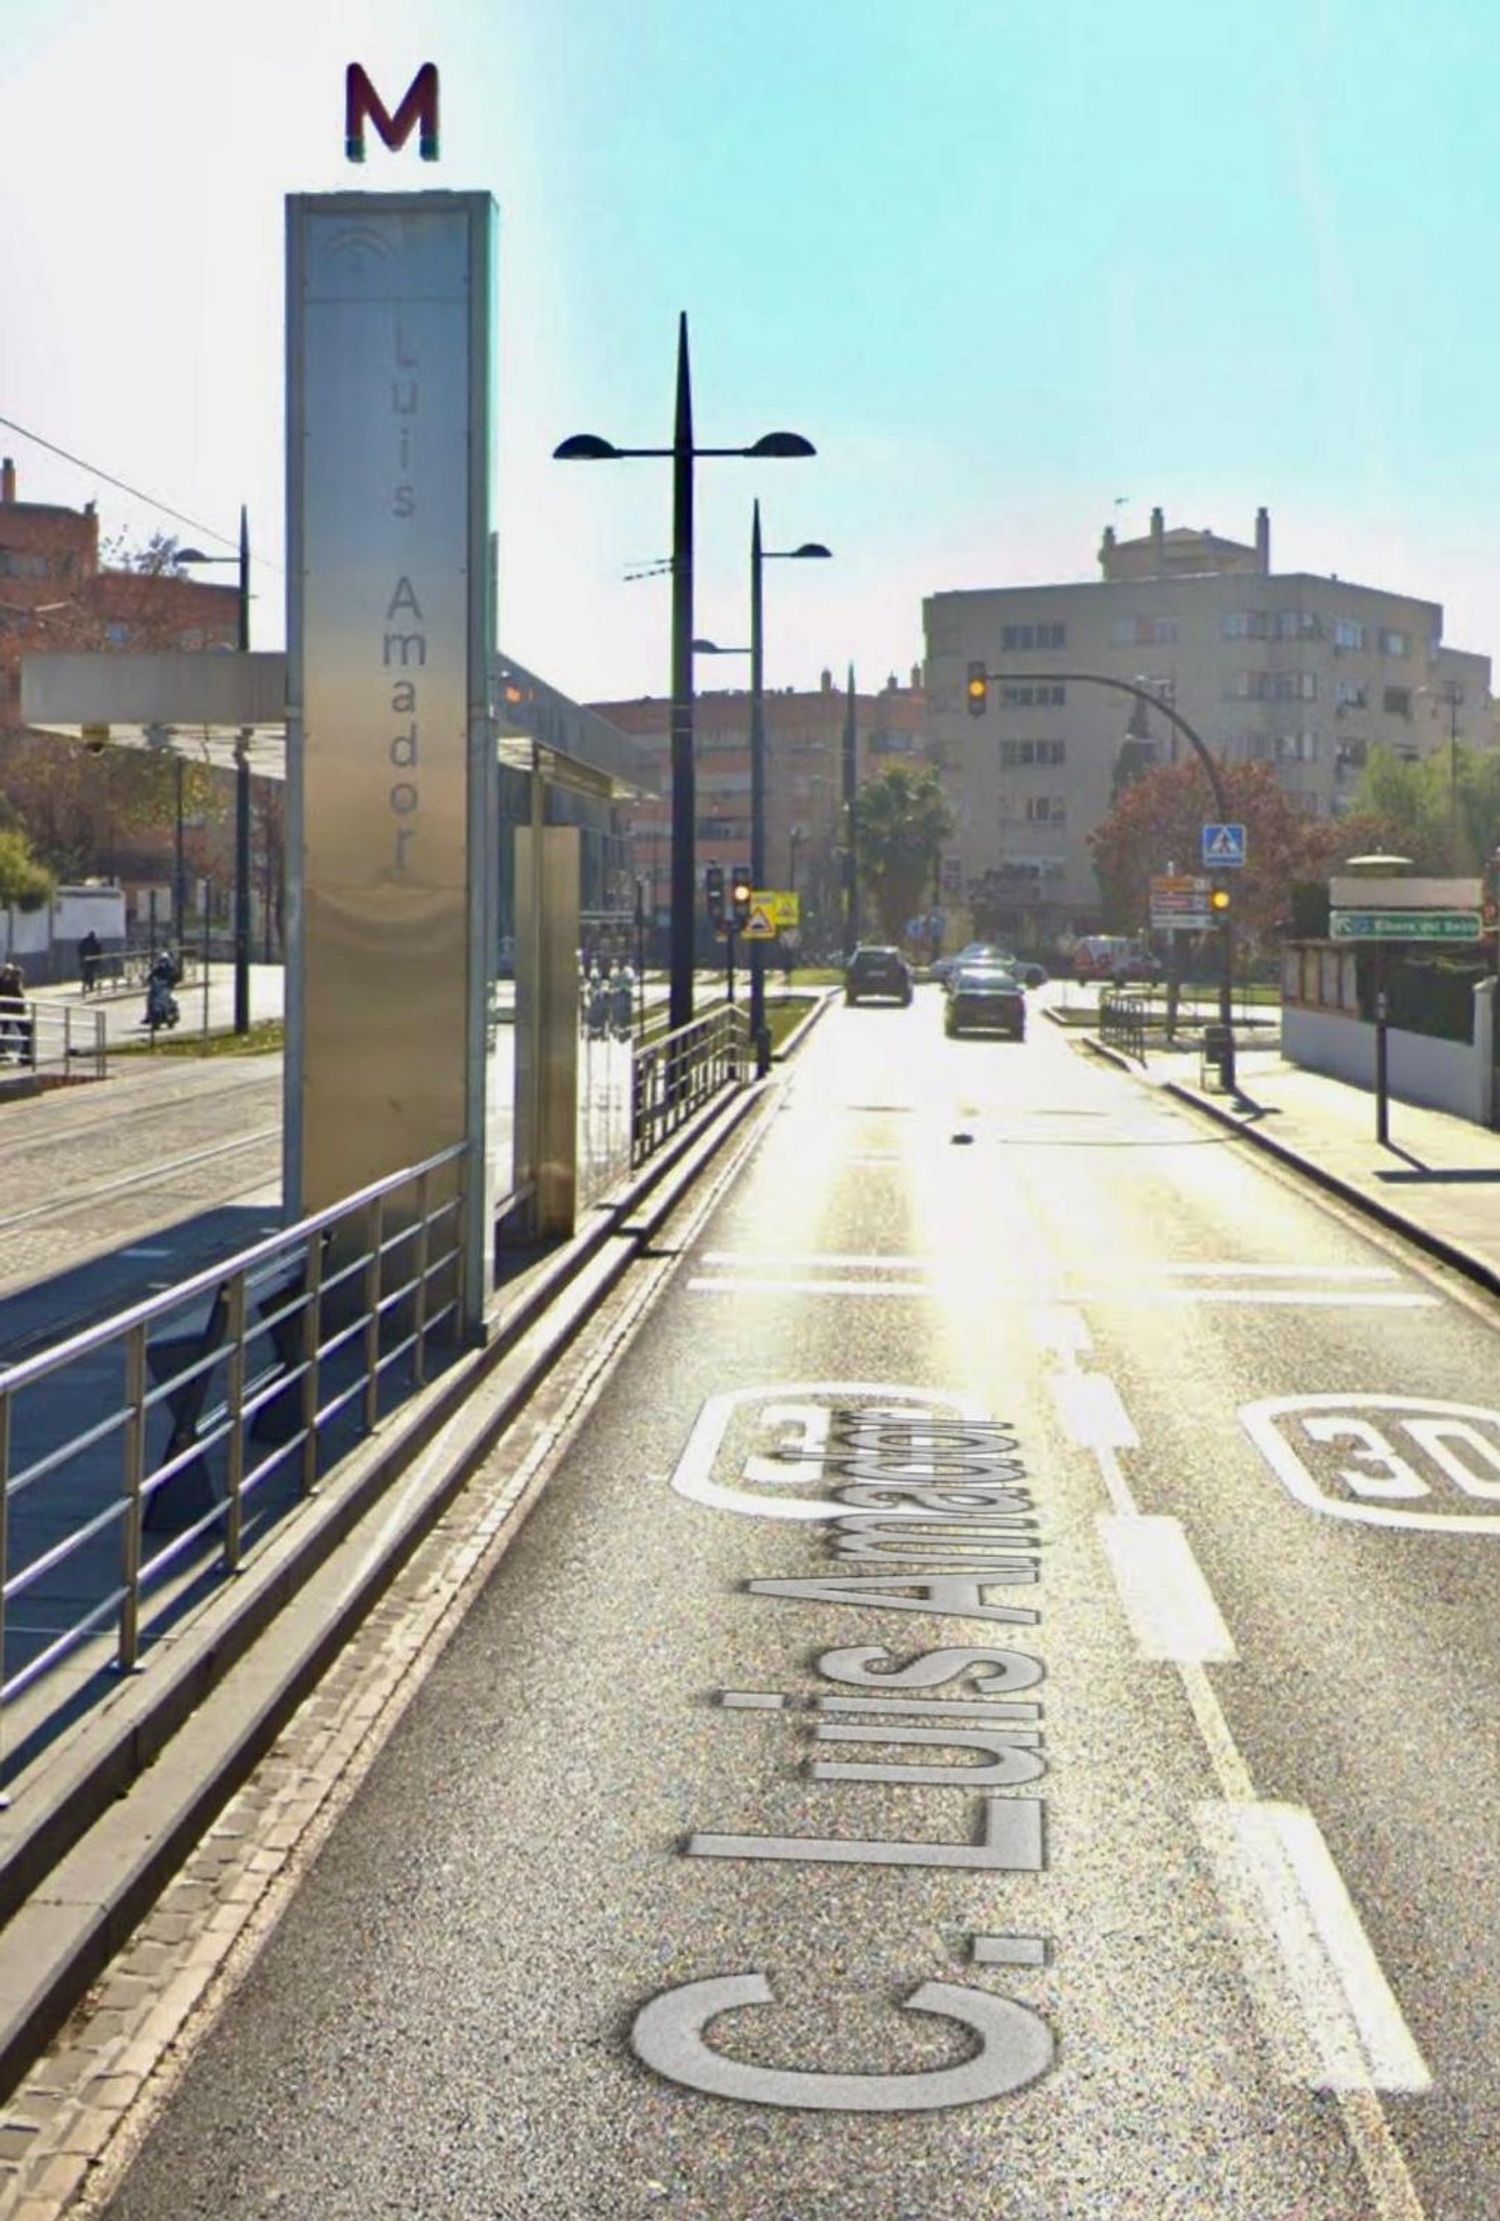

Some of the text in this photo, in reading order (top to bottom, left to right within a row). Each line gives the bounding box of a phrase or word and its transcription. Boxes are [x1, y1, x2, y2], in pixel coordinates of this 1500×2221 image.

[345, 62, 441, 163] M
[382, 320, 427, 871] Luis Amador
[1302, 1417, 1500, 1500] 30
